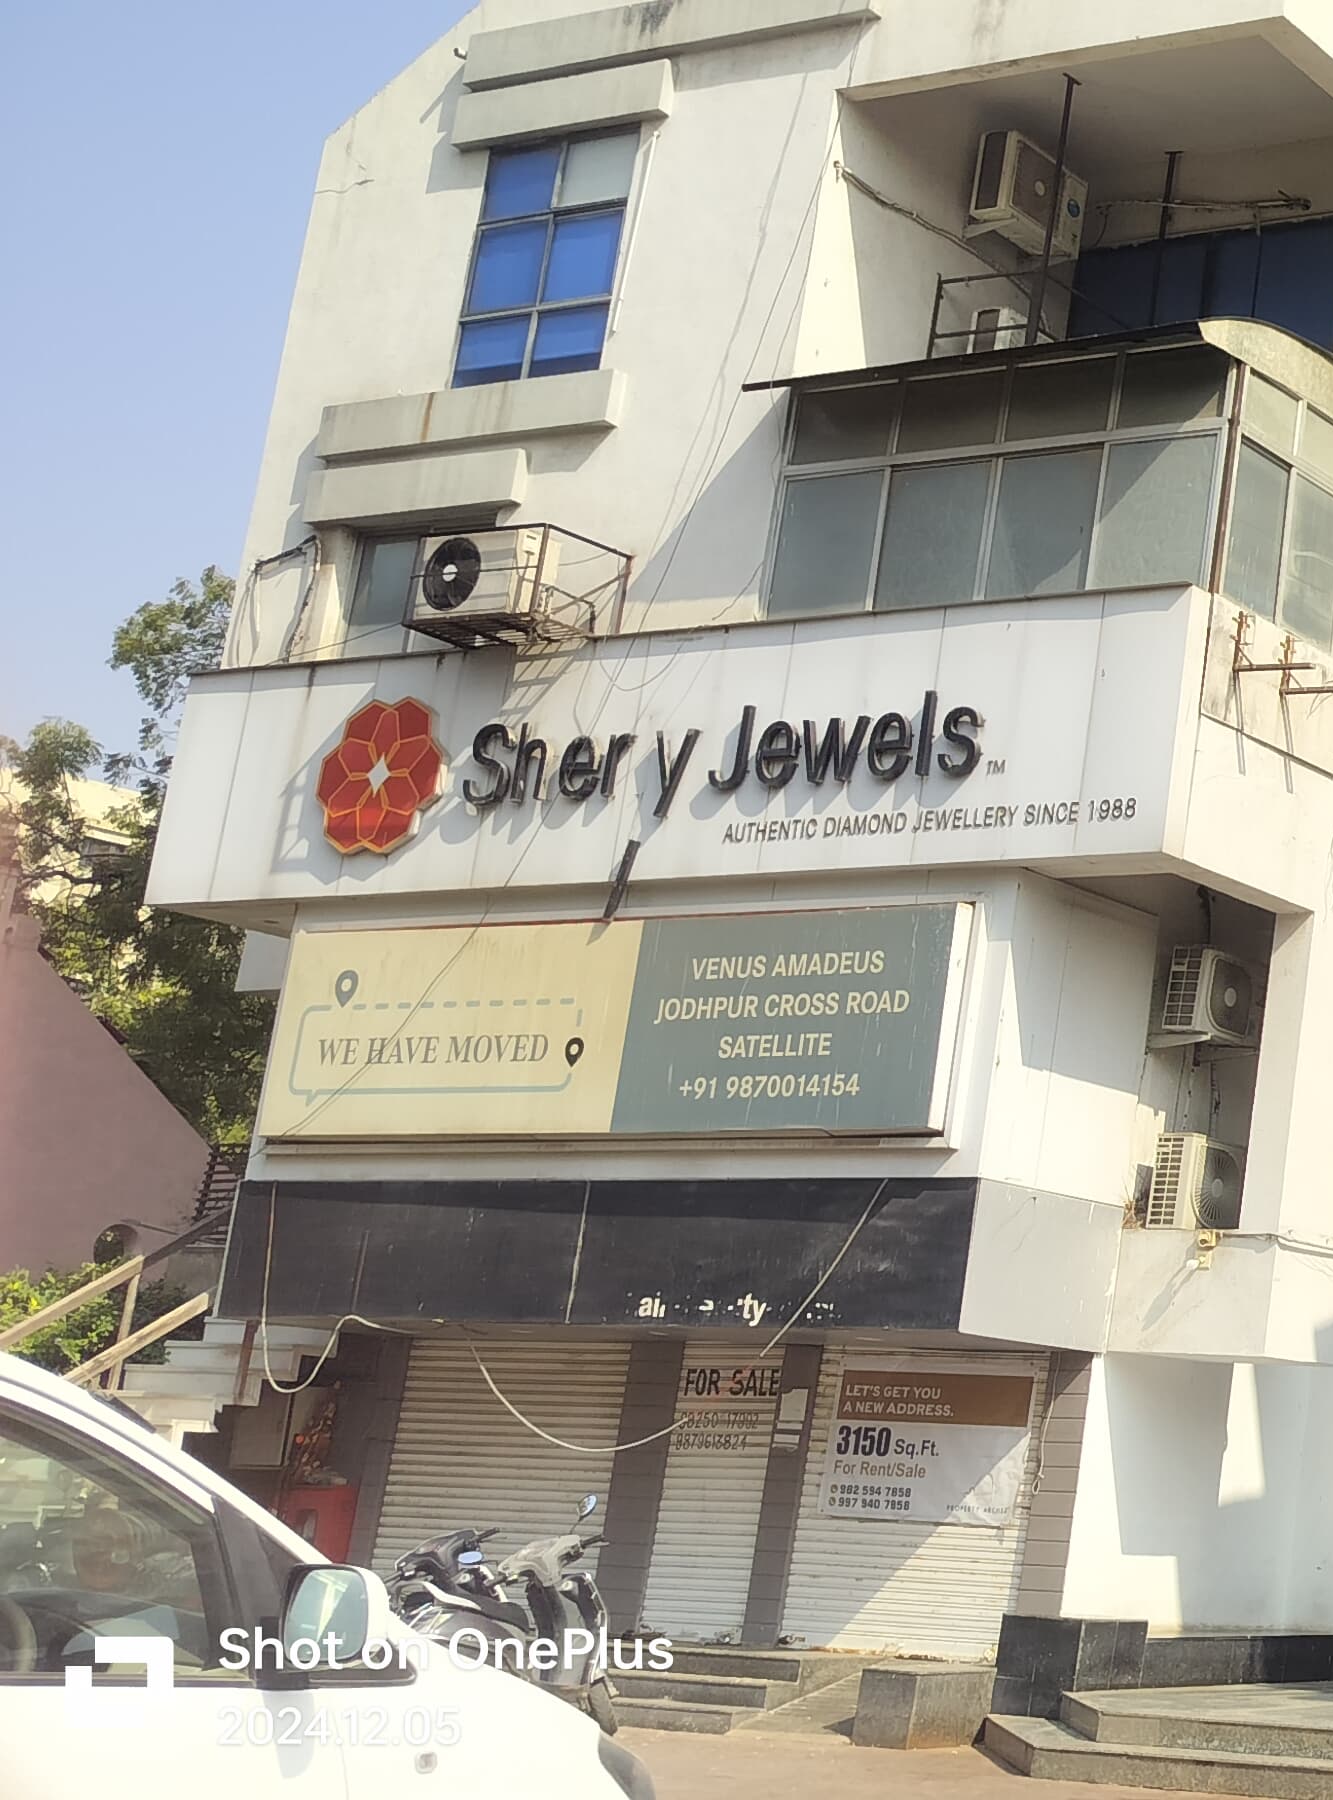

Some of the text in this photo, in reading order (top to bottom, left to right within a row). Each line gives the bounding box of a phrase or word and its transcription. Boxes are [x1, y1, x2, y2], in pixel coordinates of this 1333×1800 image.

[708, 690, 984, 790] Jewels
[722, 798, 1137, 844] AUTHENTIC DIAMOND JEWELLERY SINCE 1988
[692, 950, 885, 980] VENUS AMADEUS
[653, 989, 910, 1025] JODHPUR CROSS ROAD
[318, 1033, 549, 1065] WE HAVE MOVED
[718, 1033, 832, 1059] SATELLITE
[679, 1073, 860, 1100] +91 9870014154
[683, 1368, 780, 1396] FOR SALE
[845, 1385, 941, 1399] LET'S GET YOU
[842, 1402, 954, 1417] A NEW ADDRESS.
[836, 1425, 940, 1459] 3150 Sq.Ft.
[833, 1460, 927, 1479] For Rent/Sale
